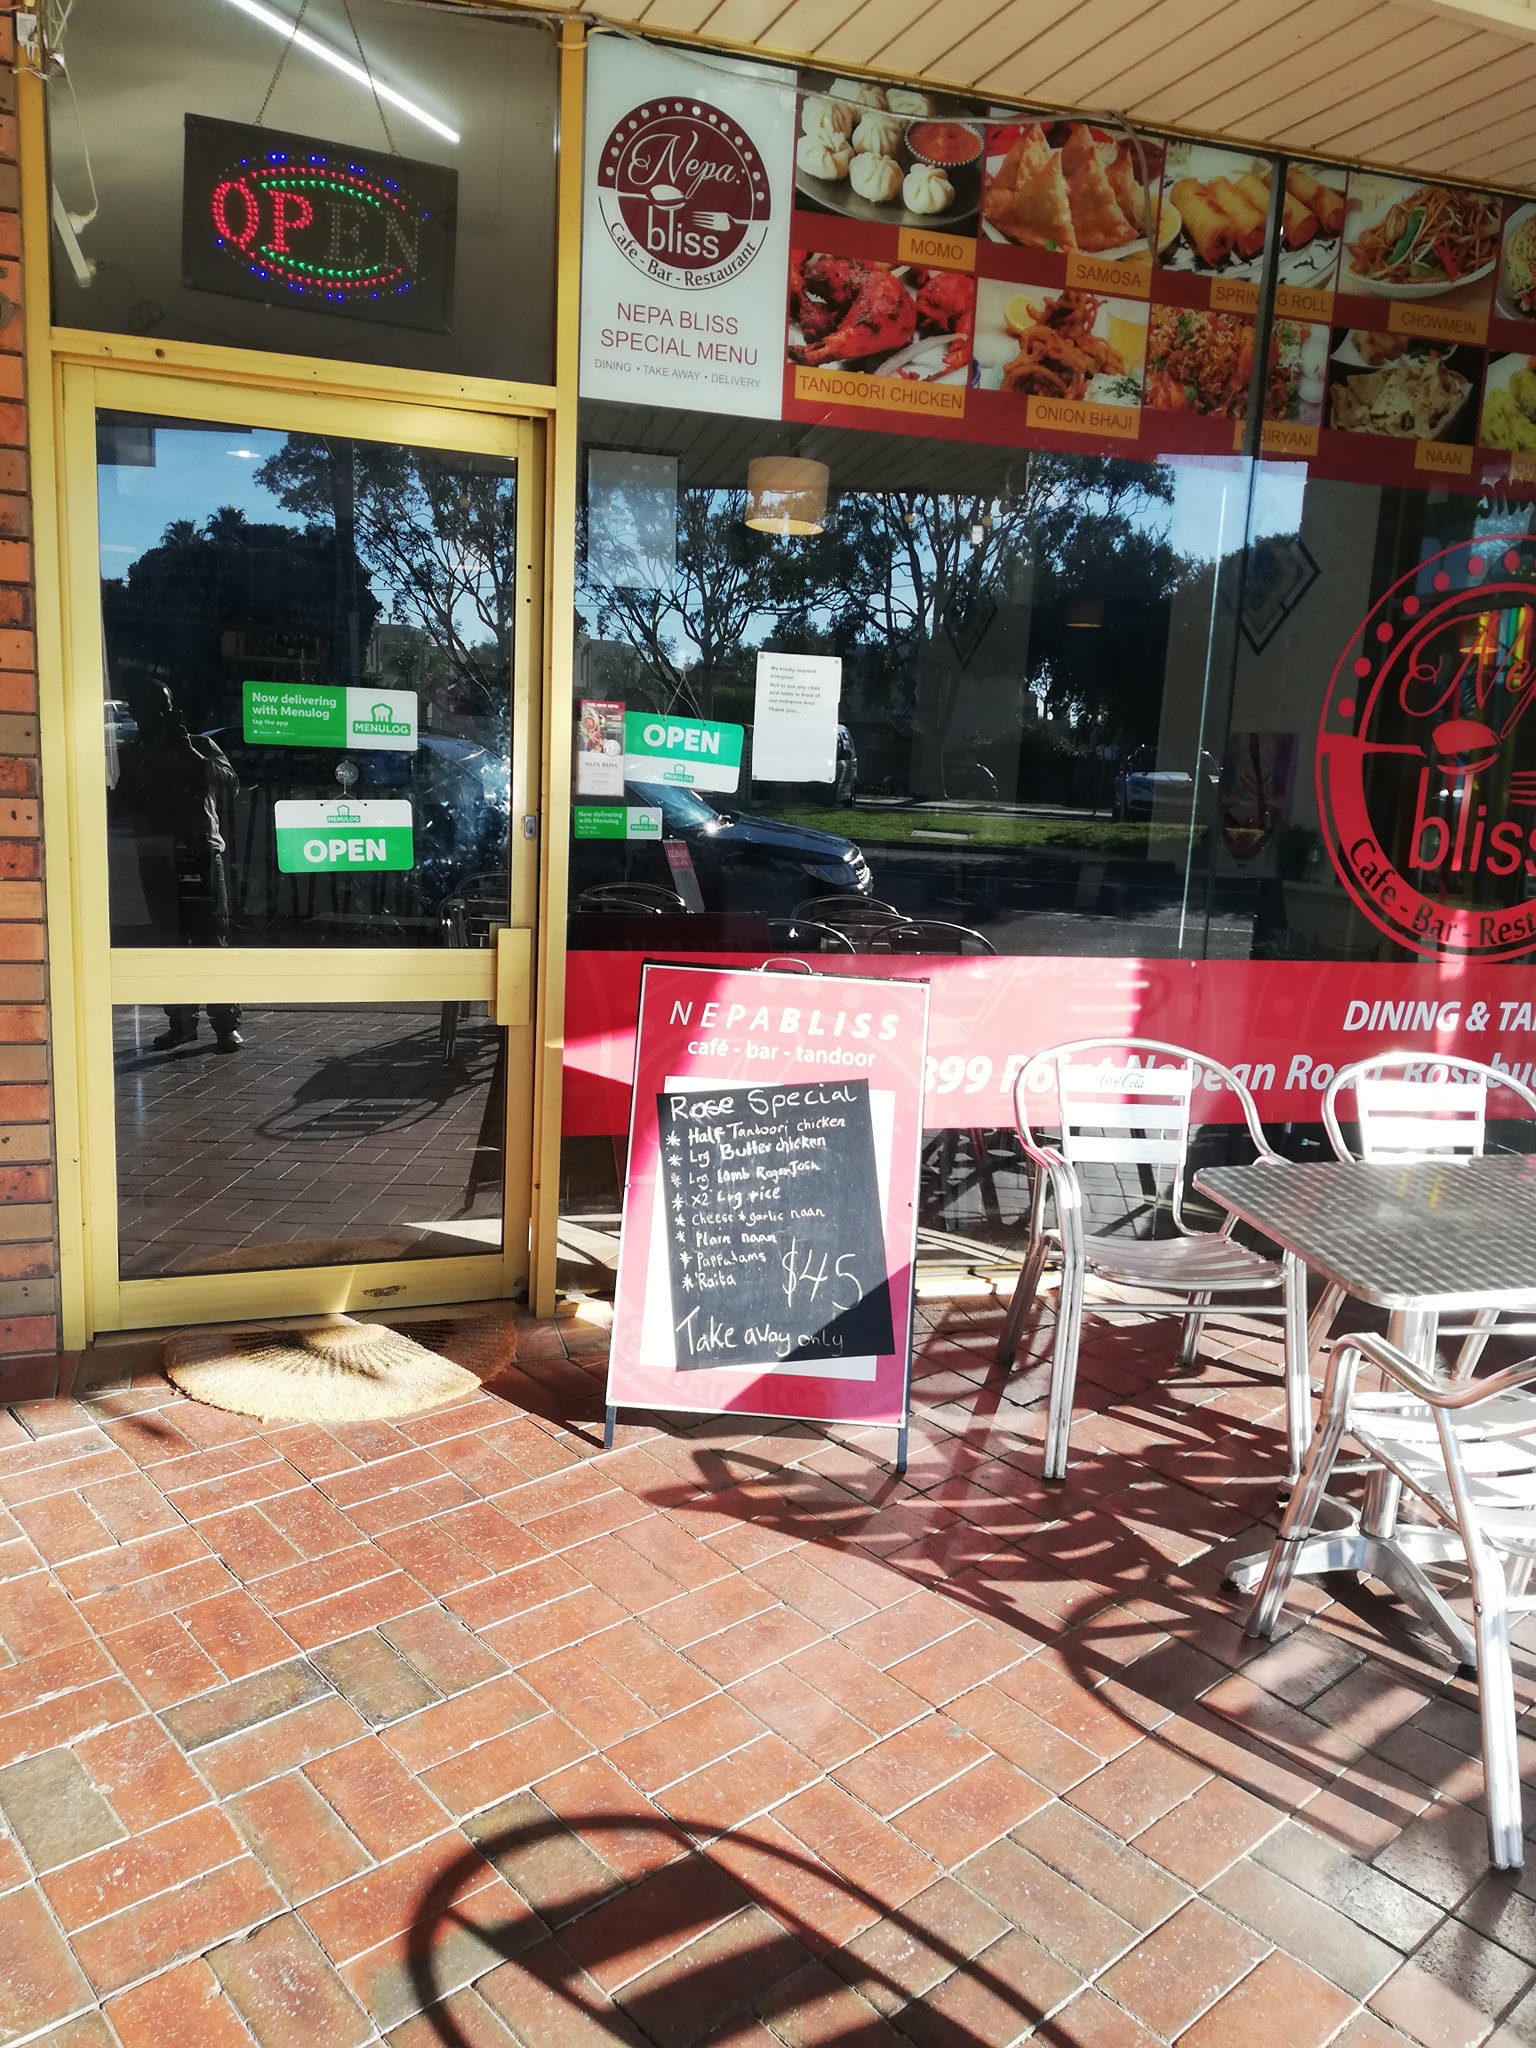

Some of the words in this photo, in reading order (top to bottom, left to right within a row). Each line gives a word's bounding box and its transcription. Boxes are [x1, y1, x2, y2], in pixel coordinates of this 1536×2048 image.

[211, 181, 420, 272] OPEN
[647, 205, 720, 258] bliss
[610, 221, 638, 259] Cafe
[647, 259, 673, 283] Bar
[685, 240, 756, 287] Restaurant
[911, 238, 963, 260] MOMO
[1076, 264, 1142, 288] SAMOSA
[1291, 294, 1329, 313] ROLL
[617, 302, 674, 327] NEPA
[679, 310, 738, 335] BLISS
[1401, 311, 1477, 335] CHOWMEIN
[601, 328, 691, 357] SPECIAL
[697, 341, 758, 366] MENU
[594, 358, 632, 373] DINING
[643, 364, 669, 377] TAKE
[671, 368, 700, 381] AWAY
[711, 373, 761, 388] DELIVERY
[800, 375, 885, 400] TANDOORI
[890, 386, 963, 409] CHICKEN
[1035, 405, 1086, 425] ONION
[1090, 412, 1132, 431] BHAJI
[1425, 449, 1463, 465] NAAN
[1400, 602, 1536, 739] Ne
[252, 691, 279, 704] Now
[280, 693, 337, 709] delivering
[252, 705, 278, 716] with
[280, 706, 330, 720] Menulog
[354, 722, 409, 735] MENULOG
[643, 723, 720, 754] OPEN
[327, 815, 360, 823] MENULOG
[593, 811, 623, 819] delivering
[303, 838, 387, 863] OPEN
[1350, 837, 1397, 909] Cafe
[1411, 902, 1458, 942] Bar
[670, 1000, 899, 1041] NEPABLISS
[1343, 1000, 1461, 1031] DINING
[1465, 1001, 1490, 1031] &
[1499, 1002, 1536, 1031] TA
[687, 1037, 728, 1056] café
[746, 1039, 779, 1060] bar
[797, 1046, 876, 1066] tandoor
[670, 1096, 735, 1121] Rose
[747, 1083, 858, 1118] Special
[726, 1121, 789, 1139] Tandoori
[797, 1116, 846, 1132] chicken
[690, 1148, 711, 1168] Lrg
[719, 1140, 772, 1160] Butter
[689, 1172, 710, 1190] Lrg
[748, 1186, 780, 1203] rice
[746, 1210, 783, 1227] garlic
[790, 1208, 825, 1219] naan
[741, 1232, 778, 1244] naan
[782, 1237, 863, 1310] $45
[675, 1306, 738, 1355] Take
[797, 1330, 844, 1357] only
